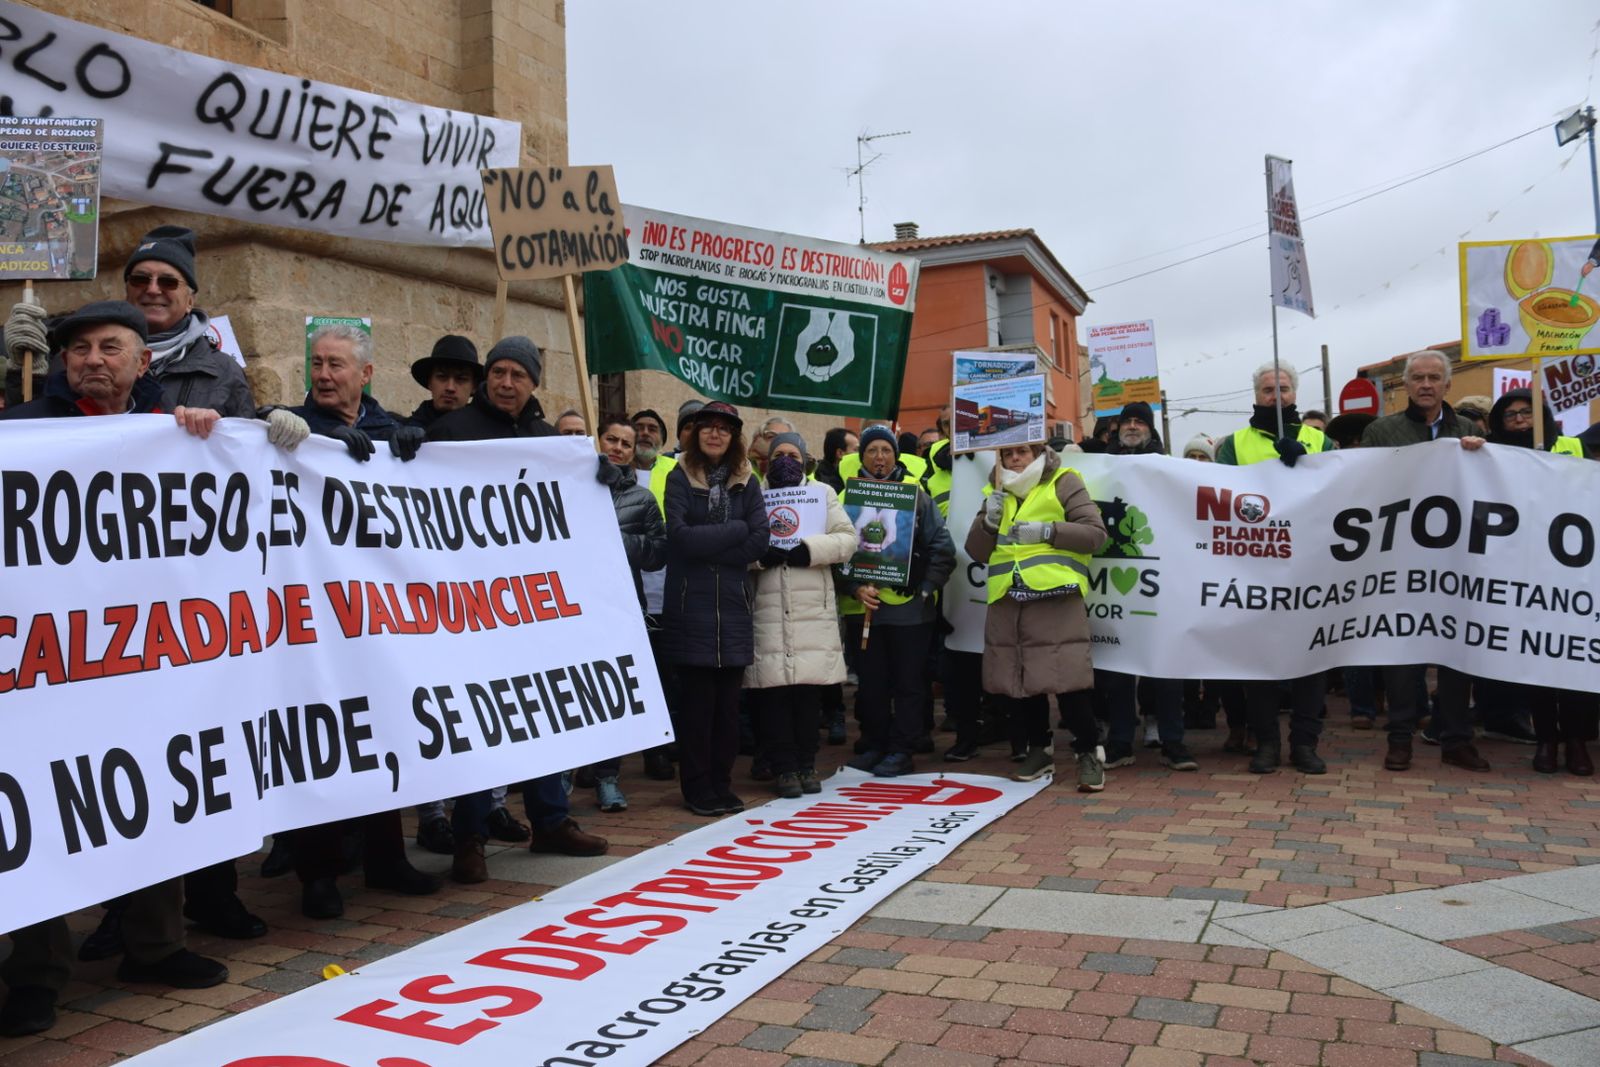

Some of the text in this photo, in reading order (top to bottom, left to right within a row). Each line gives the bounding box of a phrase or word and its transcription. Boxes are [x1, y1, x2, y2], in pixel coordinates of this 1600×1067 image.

[22, 118, 98, 126] AYUNTAMIENTO
[51, 129, 96, 137] ROZADOS
[195, 71, 398, 161] QUIERE
[419, 110, 496, 170] VIVIR
[0, 141, 97, 152] QUIERE DESTRUIR
[146, 142, 347, 221] FUERA
[360, 183, 411, 227] DE
[563, 190, 580, 212] a
[586, 169, 615, 217] la
[640, 248, 660, 261] STOP
[661, 251, 721, 275] MACROPLANTAS
[725, 265, 736, 276] DE
[769, 271, 777, 283] Y
[777, 273, 829, 290] MACROGRANJAS
[833, 281, 842, 293] EN
[844, 282, 869, 295] CASTILLA
[670, 226, 687, 251] ES
[691, 229, 775, 271] PROGRESO,
[781, 246, 798, 271] ES
[800, 249, 886, 285] DESTRUCCIÓN!
[655, 276, 751, 311] NOS GUSTA
[639, 289, 766, 339] NUESTRA FINCA
[651, 315, 742, 365] NO TOCAR
[679, 356, 756, 398] GRACIAS
[1544, 354, 1595, 391] NO
[858, 482, 898, 491] TORNADIZOS
[884, 492, 914, 500] ENTORNO
[1196, 485, 1271, 524] NO
[270, 469, 306, 548] ES
[321, 468, 571, 552] DESTRUCCIÓN
[1279, 520, 1291, 528] LA
[1329, 495, 1520, 562] STOP
[1196, 542, 1208, 550] DE
[1213, 525, 1291, 542] PLANTA
[323, 570, 582, 639] VALDUNCIEL
[1200, 569, 1600, 622] FÁBRICAS DE BIOMETANO,
[1308, 612, 1457, 651] ALEJADAS
[1465, 620, 1509, 651] DE
[50, 746, 149, 855] NO
[166, 725, 232, 825] SE
[412, 685, 473, 760] SE
[464, 654, 646, 748] DEFIENDE
[905, 835, 946, 845] y
[912, 810, 980, 834] León
[819, 845, 927, 895] Castilla
[334, 801, 903, 1046] ES DESTRUCCIÓN!
[790, 896, 846, 918] en
